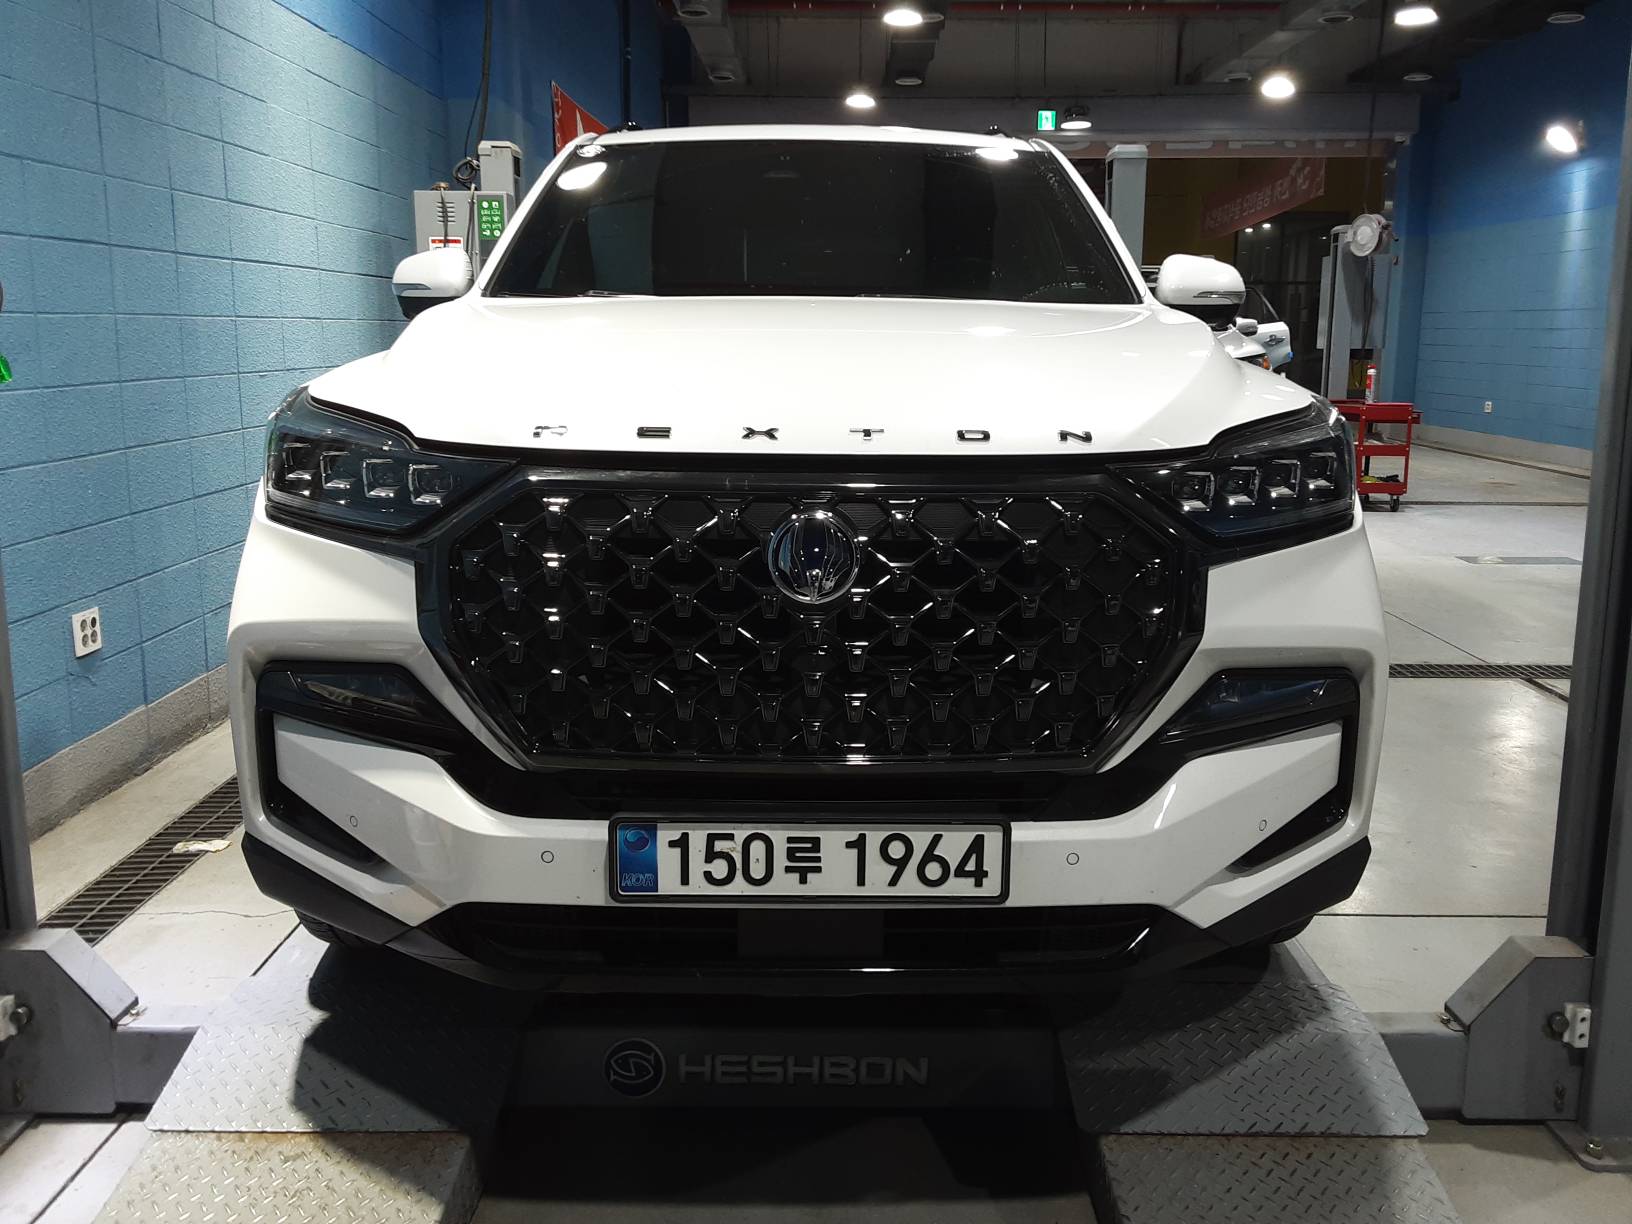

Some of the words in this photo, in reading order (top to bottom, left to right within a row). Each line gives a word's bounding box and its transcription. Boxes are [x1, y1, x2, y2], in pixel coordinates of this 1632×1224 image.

[532, 424, 1093, 444] REXTON
[667, 831, 823, 887] 150루
[845, 832, 989, 888] 1964
[678, 1053, 929, 1086] HESHBON
